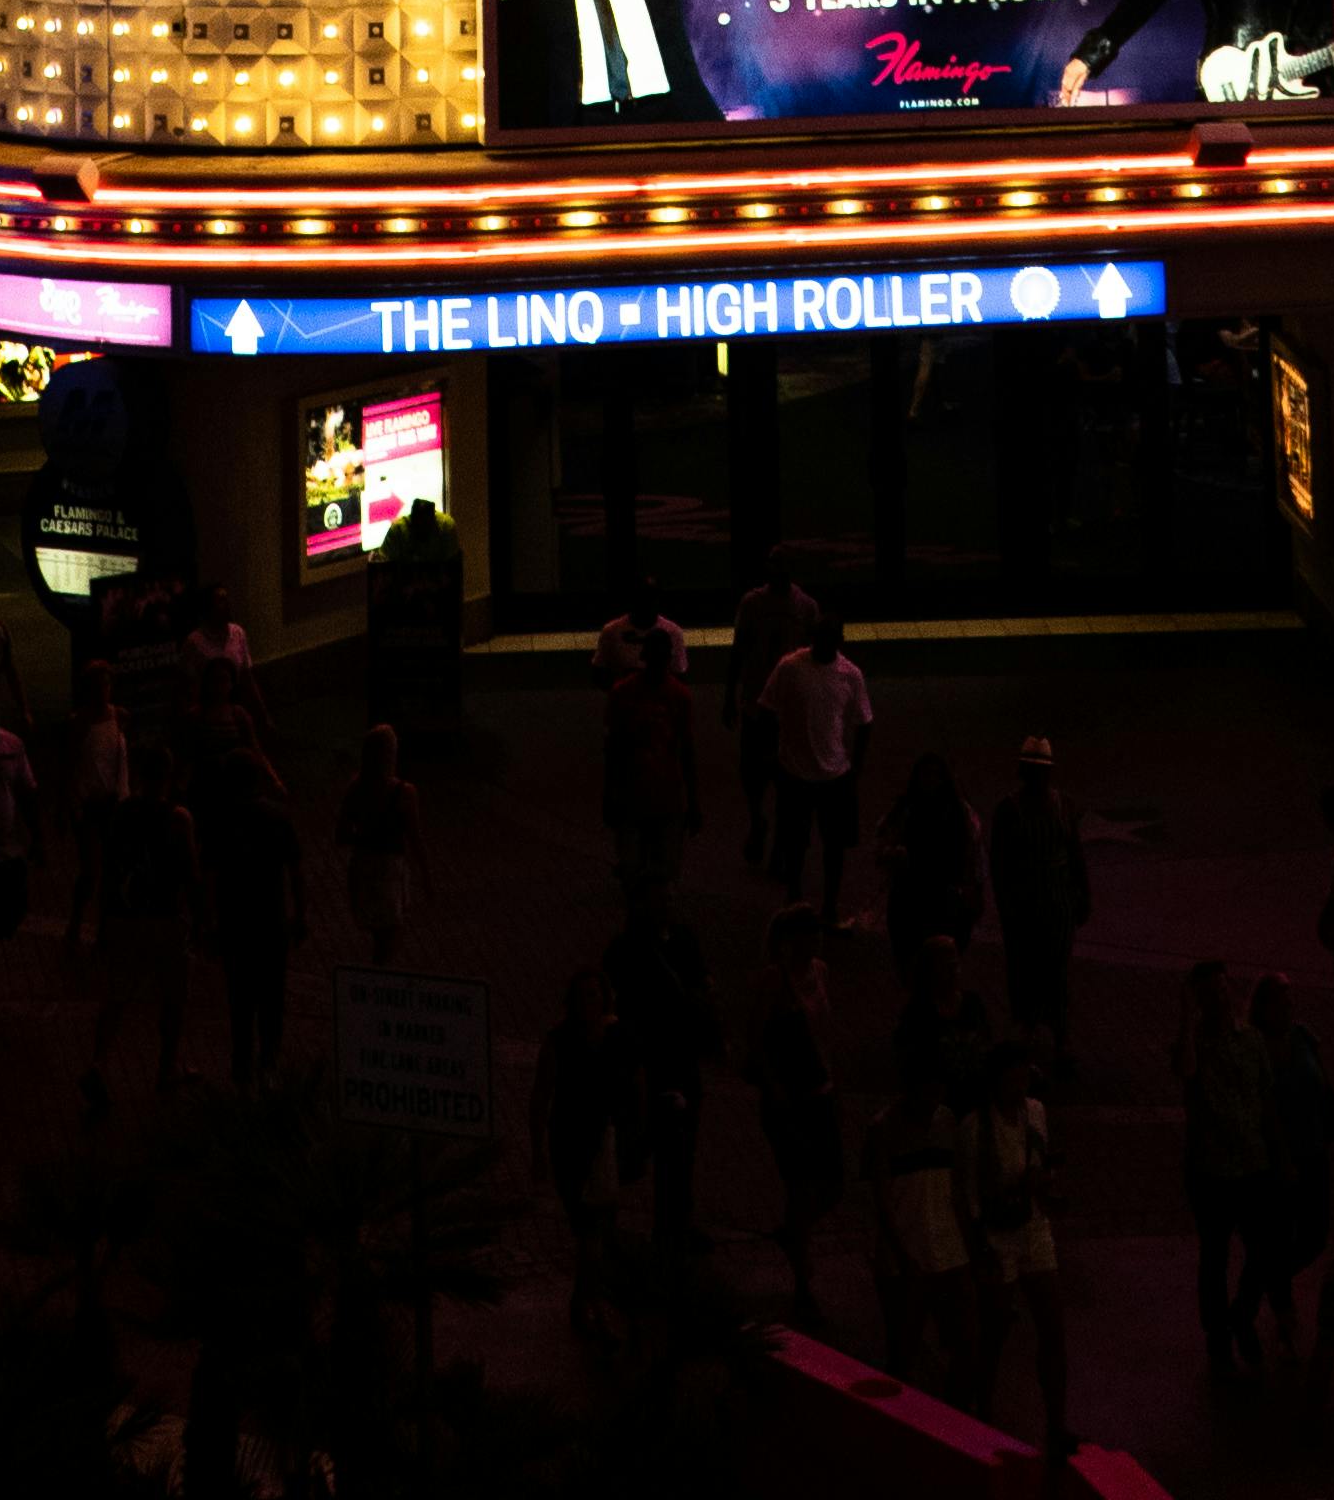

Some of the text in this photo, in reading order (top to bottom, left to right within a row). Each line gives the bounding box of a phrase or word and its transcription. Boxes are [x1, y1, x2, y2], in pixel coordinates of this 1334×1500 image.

[865, 31, 1012, 94] Flamingo
[899, 98, 980, 109] FLAMINGO.COM
[370, 271, 984, 354] THE LINQ HIGH ROLLER
[39, 517, 139, 541] CAESARS PALACE
[53, 503, 113, 523] FLAMINGO
[344, 1077, 485, 1123] PROHIBITED
